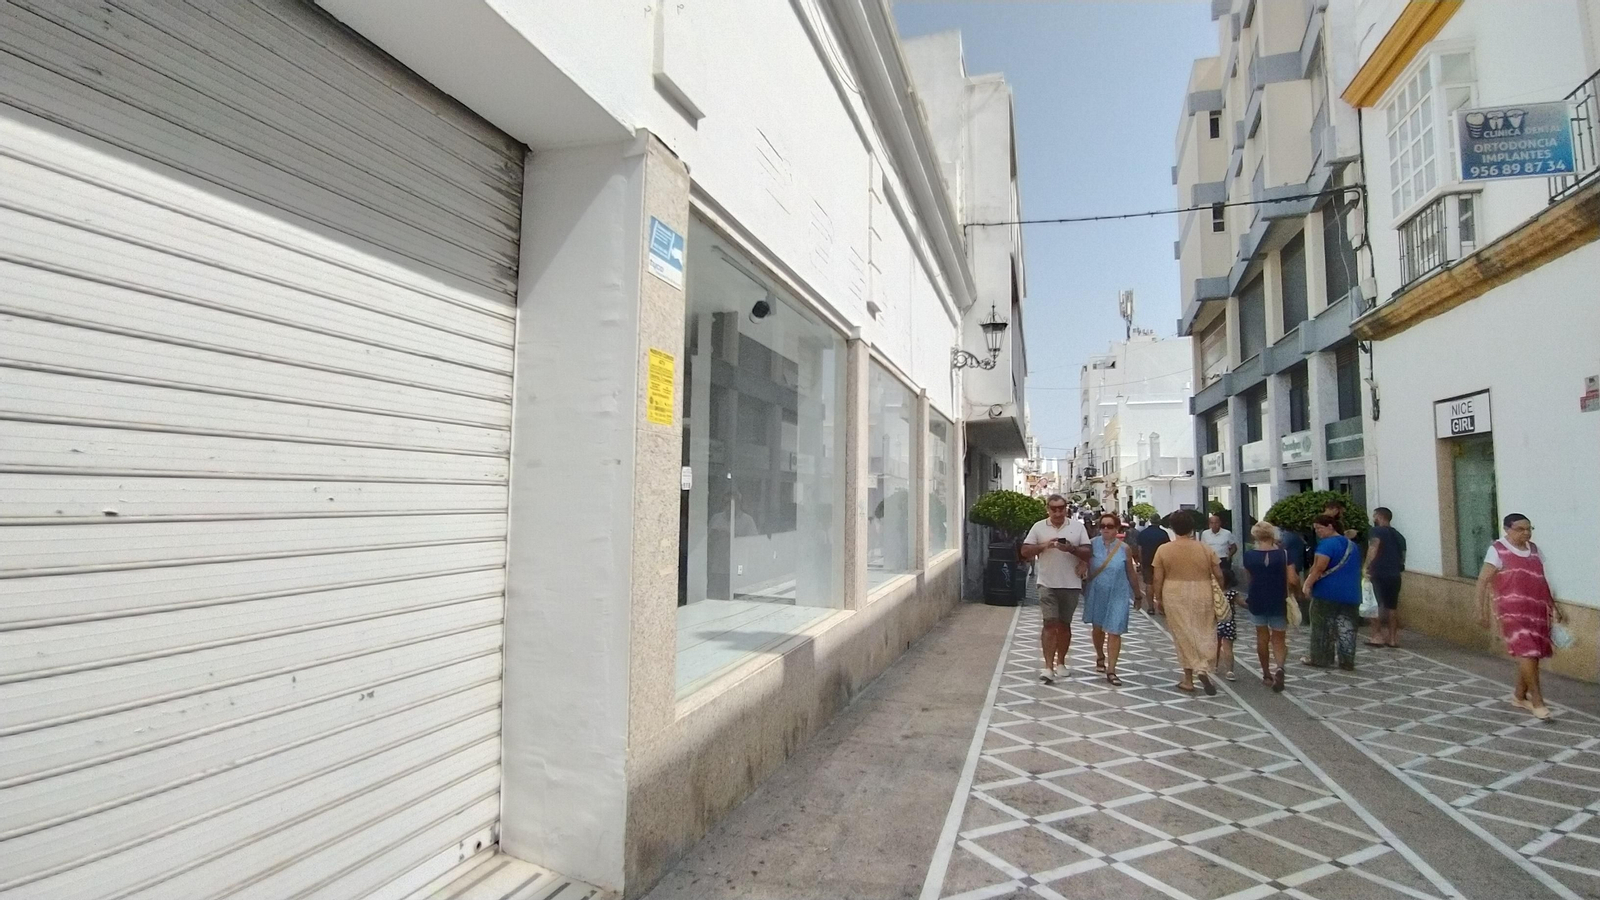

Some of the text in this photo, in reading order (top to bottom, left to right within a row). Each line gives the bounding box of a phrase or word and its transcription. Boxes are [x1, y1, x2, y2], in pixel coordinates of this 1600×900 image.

[1473, 138, 1558, 153] ORTODONCIA
[1482, 149, 1551, 164] IMPLANTES
[1470, 160, 1566, 177] 956 89 87 34
[1452, 401, 1473, 416] NICE
[1452, 417, 1474, 432] GIRL
